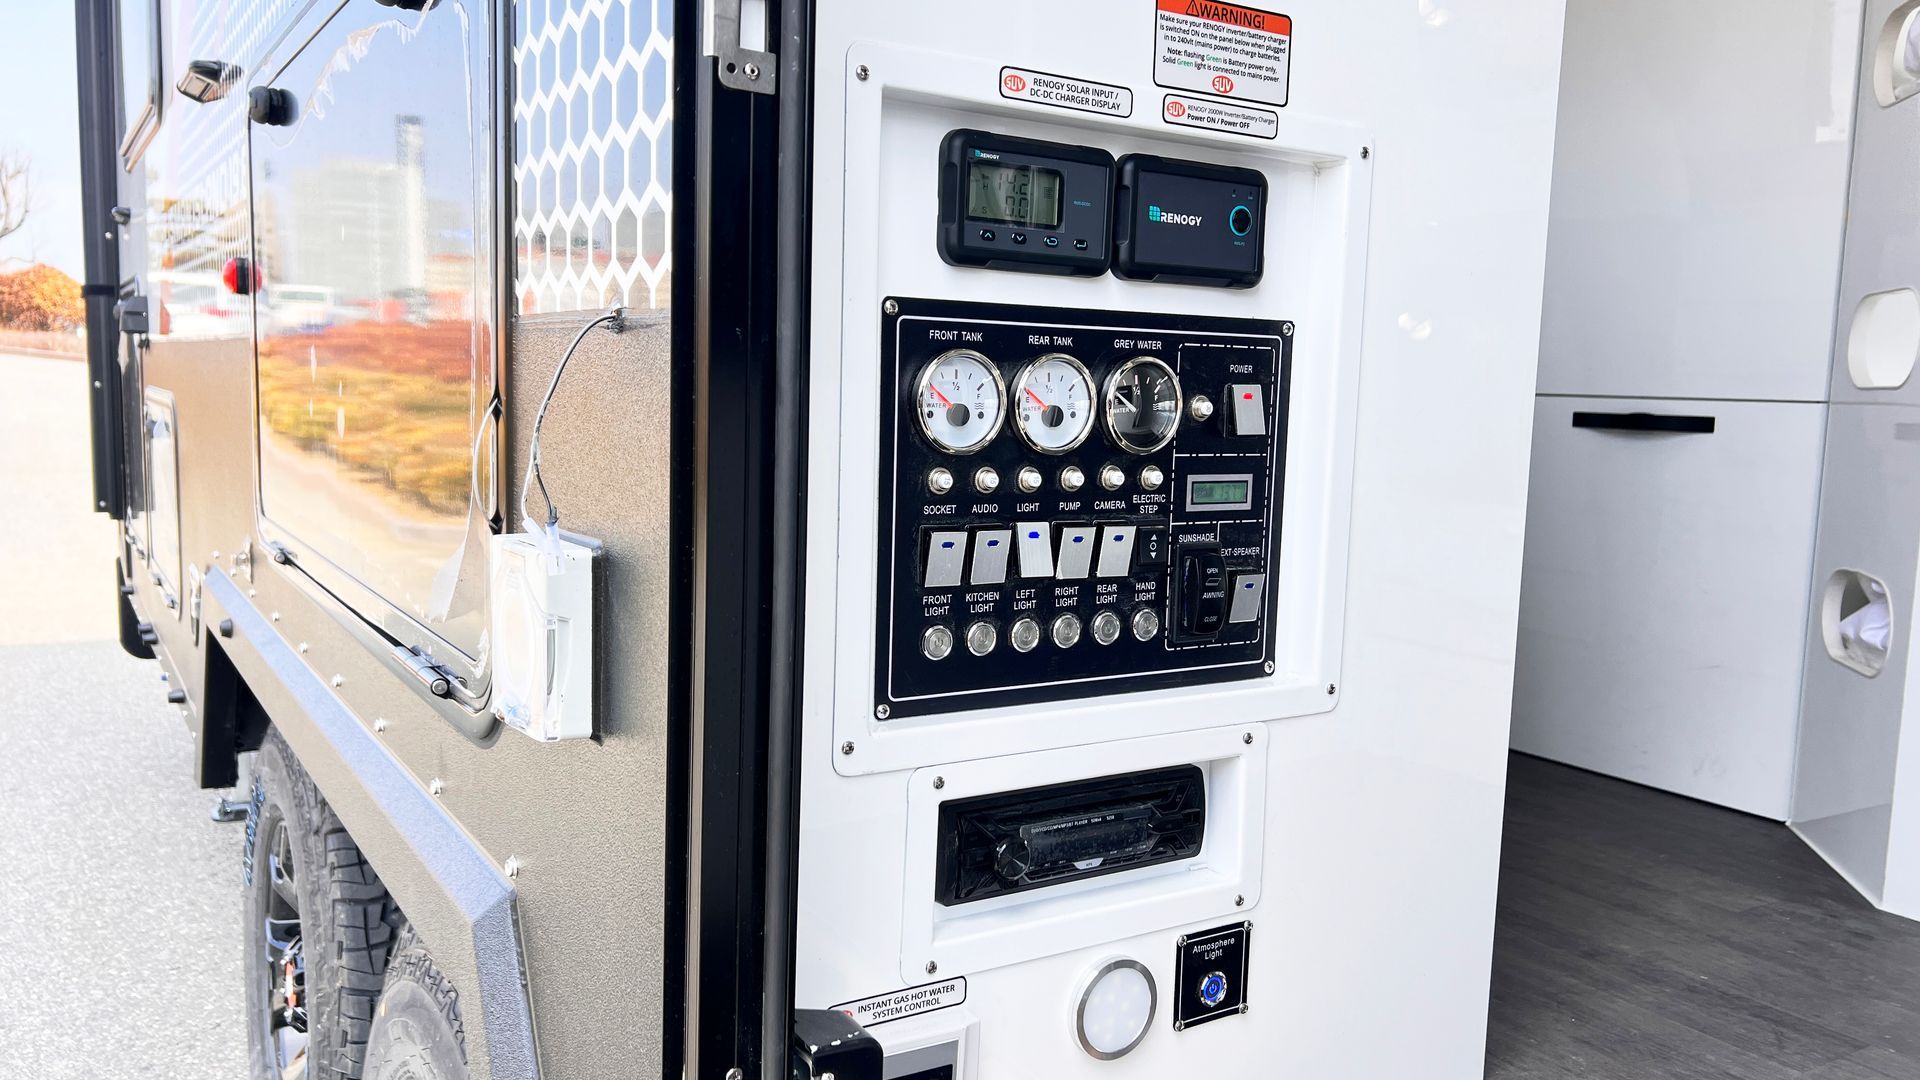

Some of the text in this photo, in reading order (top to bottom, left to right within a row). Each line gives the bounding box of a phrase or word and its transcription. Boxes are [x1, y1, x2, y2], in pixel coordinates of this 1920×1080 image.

[1200, 3, 1265, 30] WARNING!
[1160, 14, 1175, 23] Make
[1189, 20, 1202, 29] your
[1203, 21, 1225, 33] RENOGY
[1226, 27, 1267, 42] inverter/battery
[1267, 36, 1287, 46] charger
[1165, 25, 1190, 36] switched
[1209, 32, 1218, 40] the
[1219, 35, 1233, 46] panel
[1234, 37, 1250, 47] below
[1251, 40, 1265, 50] when
[1266, 43, 1286, 55] plugged
[1177, 36, 1194, 46] 240vlt
[1194, 39, 1212, 50] (mains
[1213, 43, 1233, 54] power)
[1239, 47, 1257, 59] charge
[1258, 49, 1281, 62] batteries.
[1167, 47, 1183, 56] Note:
[1183, 49, 1205, 62] flashing
[1206, 54, 1222, 64] Green
[1223, 57, 1228, 65] is
[1228, 58, 1247, 70] Battery
[1248, 63, 1264, 73] power
[1162, 55, 1176, 65] Solid
[1176, 59, 1193, 68] Green
[1194, 60, 1207, 72] light
[1207, 63, 1212, 71] is
[1212, 64, 1240, 76] connected
[1247, 72, 1263, 81] mains
[1263, 74, 1280, 84] power.
[1005, 76, 1024, 91] SUV
[1033, 78, 1065, 90] RENOGY
[1066, 83, 1090, 95] SOLAR
[1091, 88, 1114, 99] INPUT
[1213, 77, 1232, 92] SUV
[1030, 88, 1121, 111] DC-DC CHARGER DISPLAY
[1168, 102, 1184, 117] SUV
[1187, 104, 1275, 126] RENOGY 2000W Inverter/Battery Charger
[1187, 113, 1206, 122] Power
[1207, 115, 1216, 124] ON
[1220, 118, 1238, 128] Power
[1239, 121, 1250, 130] OFF
[980, 152, 1000, 160] RENOGY
[1160, 212, 1202, 227] RENOGY
[929, 330, 983, 342] FRONT TANK
[1028, 334, 1074, 347] REAR TANK
[1114, 338, 1162, 350] GREY WATER
[1229, 364, 1253, 375] POWER
[1132, 494, 1166, 504] ELECTRIC
[923, 505, 957, 515] SOCKET
[971, 503, 999, 513] AUDIO
[1016, 502, 1040, 513] LIGHT
[1059, 501, 1081, 511] PUMP
[1094, 500, 1126, 510] CAMERA
[1139, 505, 1159, 515] STEP
[1178, 533, 1215, 543] SUNSHADE
[1220, 546, 1260, 557] EXT-SPEAKER
[1054, 586, 1079, 596] RIGHT
[1096, 583, 1118, 593] REAR
[1135, 581, 1156, 591] HAND
[922, 594, 953, 605] FRONT
[965, 591, 1000, 603] KITCHEN
[1015, 589, 1036, 599] LEFT
[1096, 594, 1118, 605] LIGHT
[1134, 591, 1156, 602] LIGHT
[1202, 591, 1225, 599] AWNING
[970, 603, 995, 613] LIGHT
[1013, 600, 1037, 610] LIGHT
[1055, 597, 1078, 608] LIGHT
[924, 606, 950, 617] LIGHT
[1192, 937, 1235, 954] Atmosphere
[1204, 949, 1223, 960] Light
[858, 998, 892, 1014] INSTANT
[893, 994, 910, 1005] GAS
[910, 990, 928, 1001] HOT
[928, 984, 956, 997] WATER
[872, 997, 941, 1020] SYSTEM CONTROL
